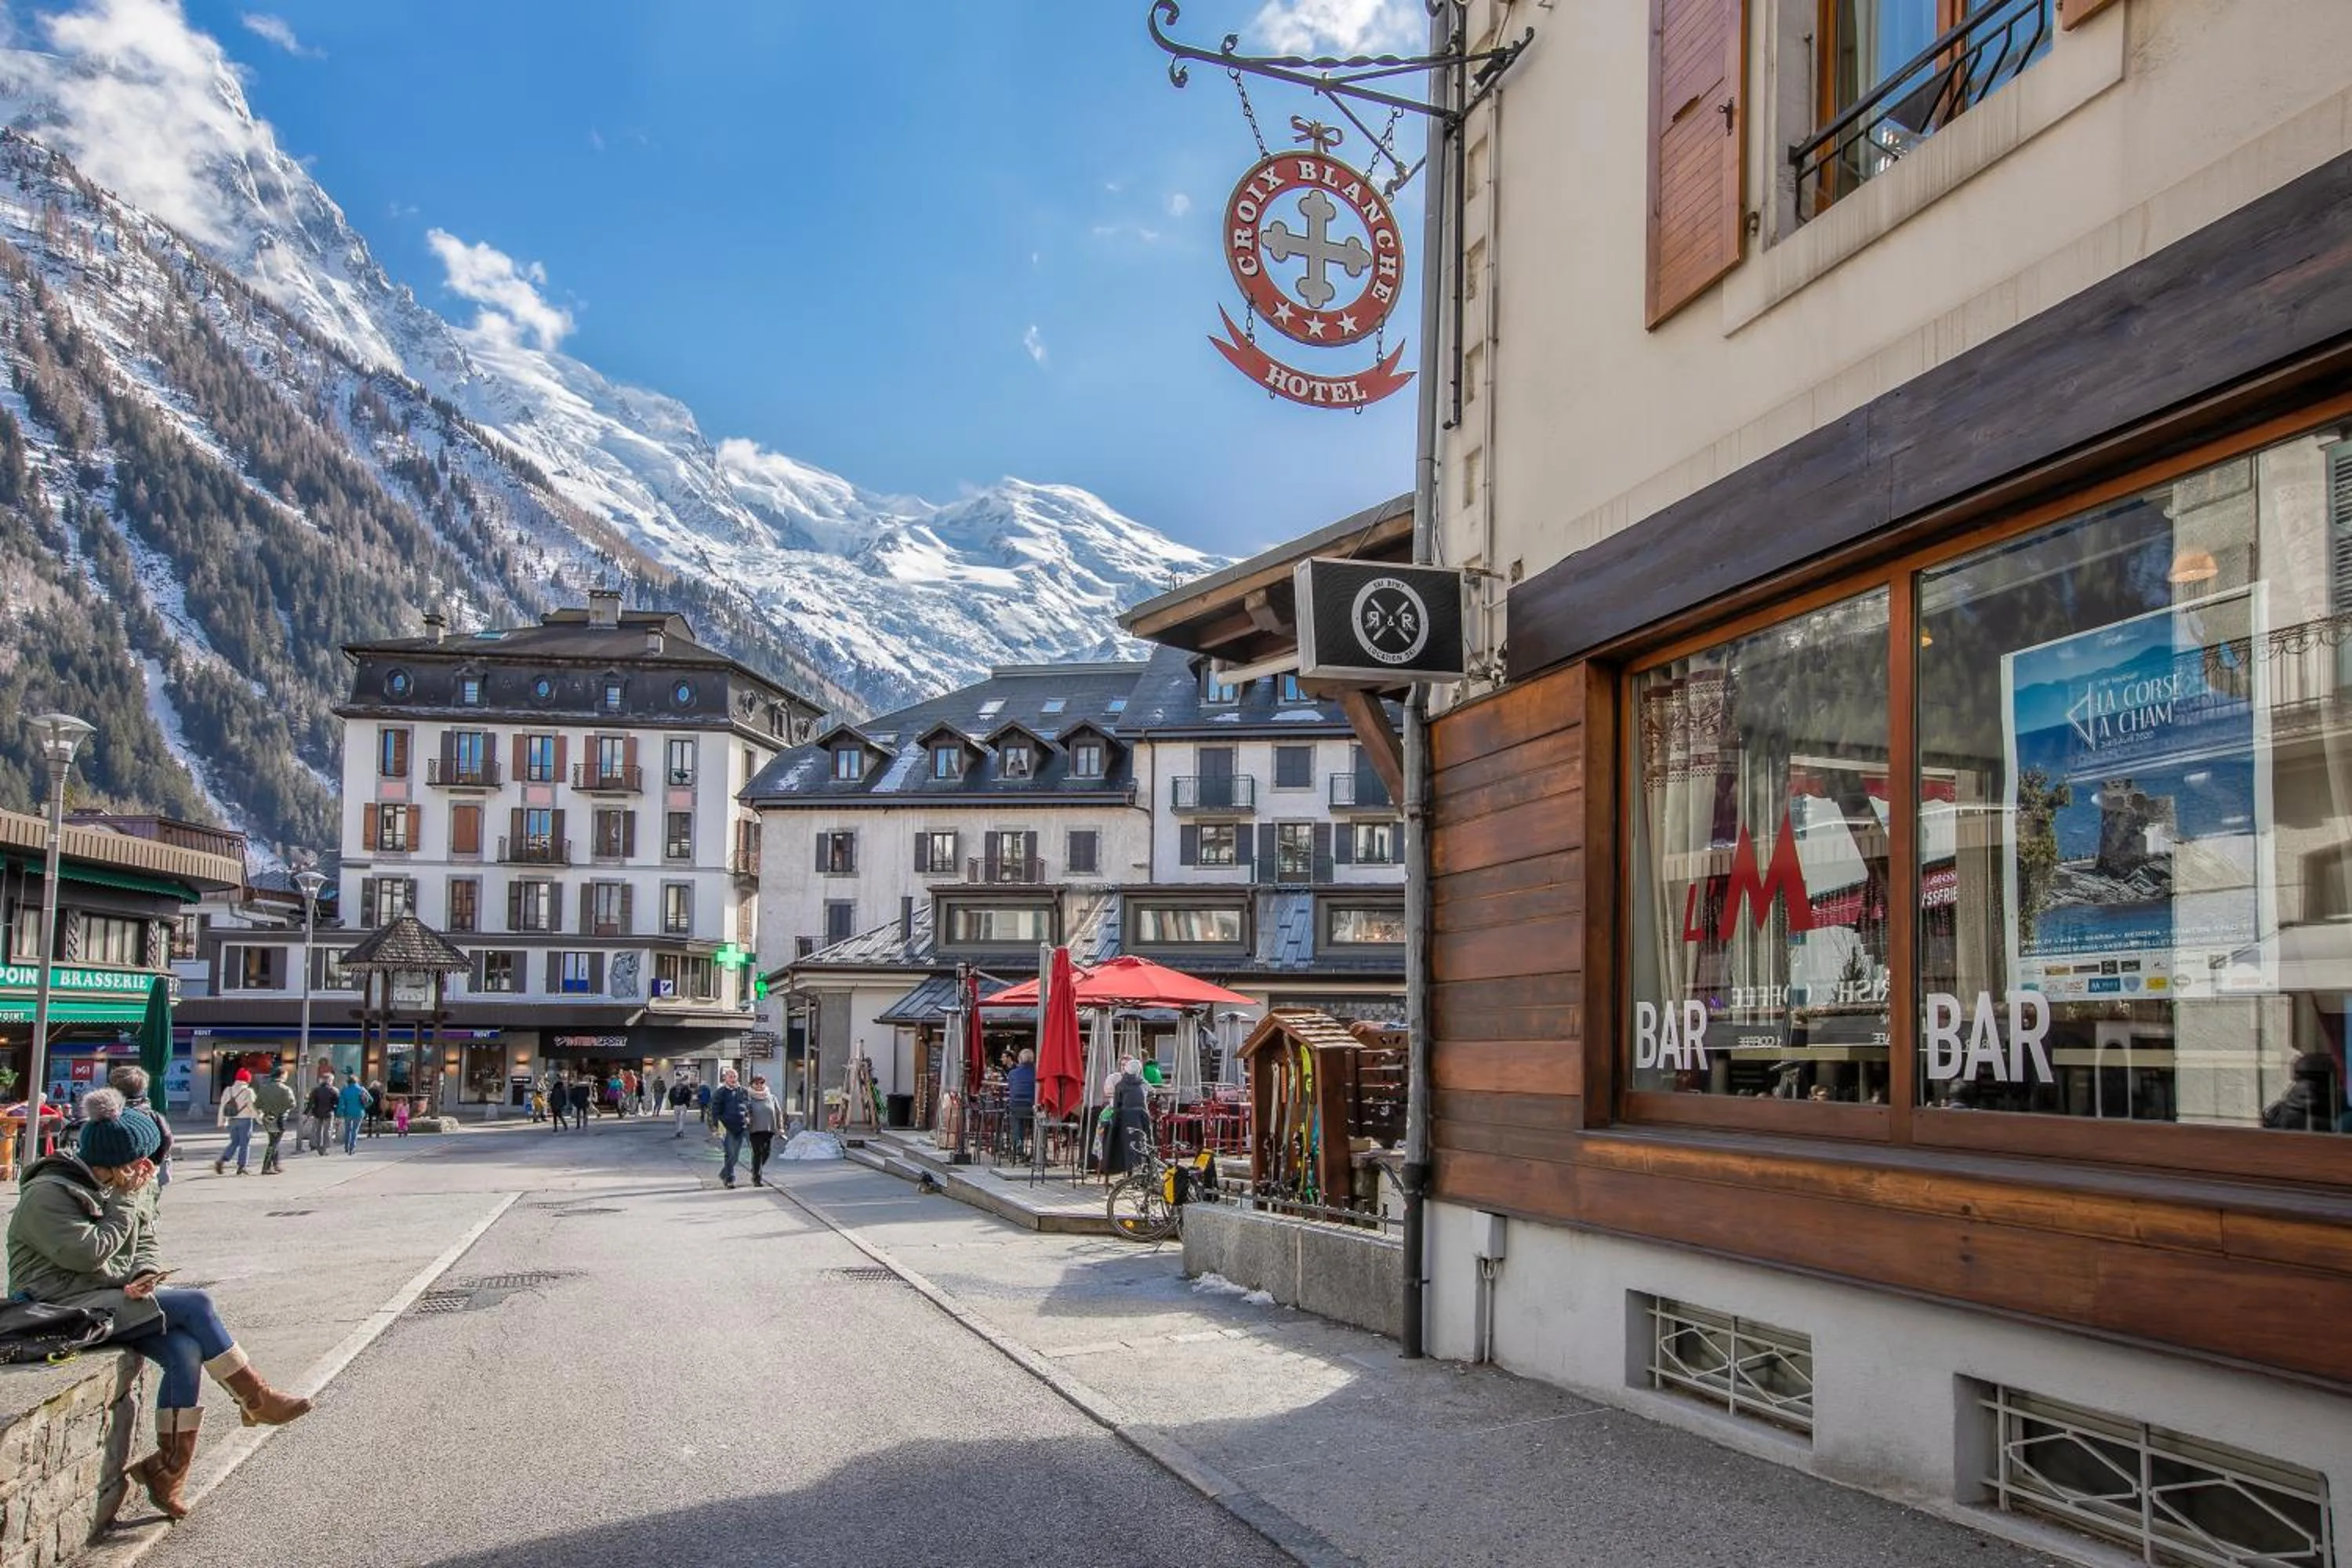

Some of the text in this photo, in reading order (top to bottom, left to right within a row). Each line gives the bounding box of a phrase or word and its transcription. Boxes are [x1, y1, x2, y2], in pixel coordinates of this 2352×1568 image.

[1233, 159, 1397, 303] CROIX BLANCHE
[1264, 363, 1368, 404] HOTEL
[1367, 645, 1403, 662] LOCATION
[2096, 689, 2117, 713] LA
[60, 970, 148, 989] BRASSERIE
[564, 1035, 627, 1047] INTERSPORT
[1635, 1000, 1709, 1071] BAR
[1926, 990, 2055, 1084] BAR
